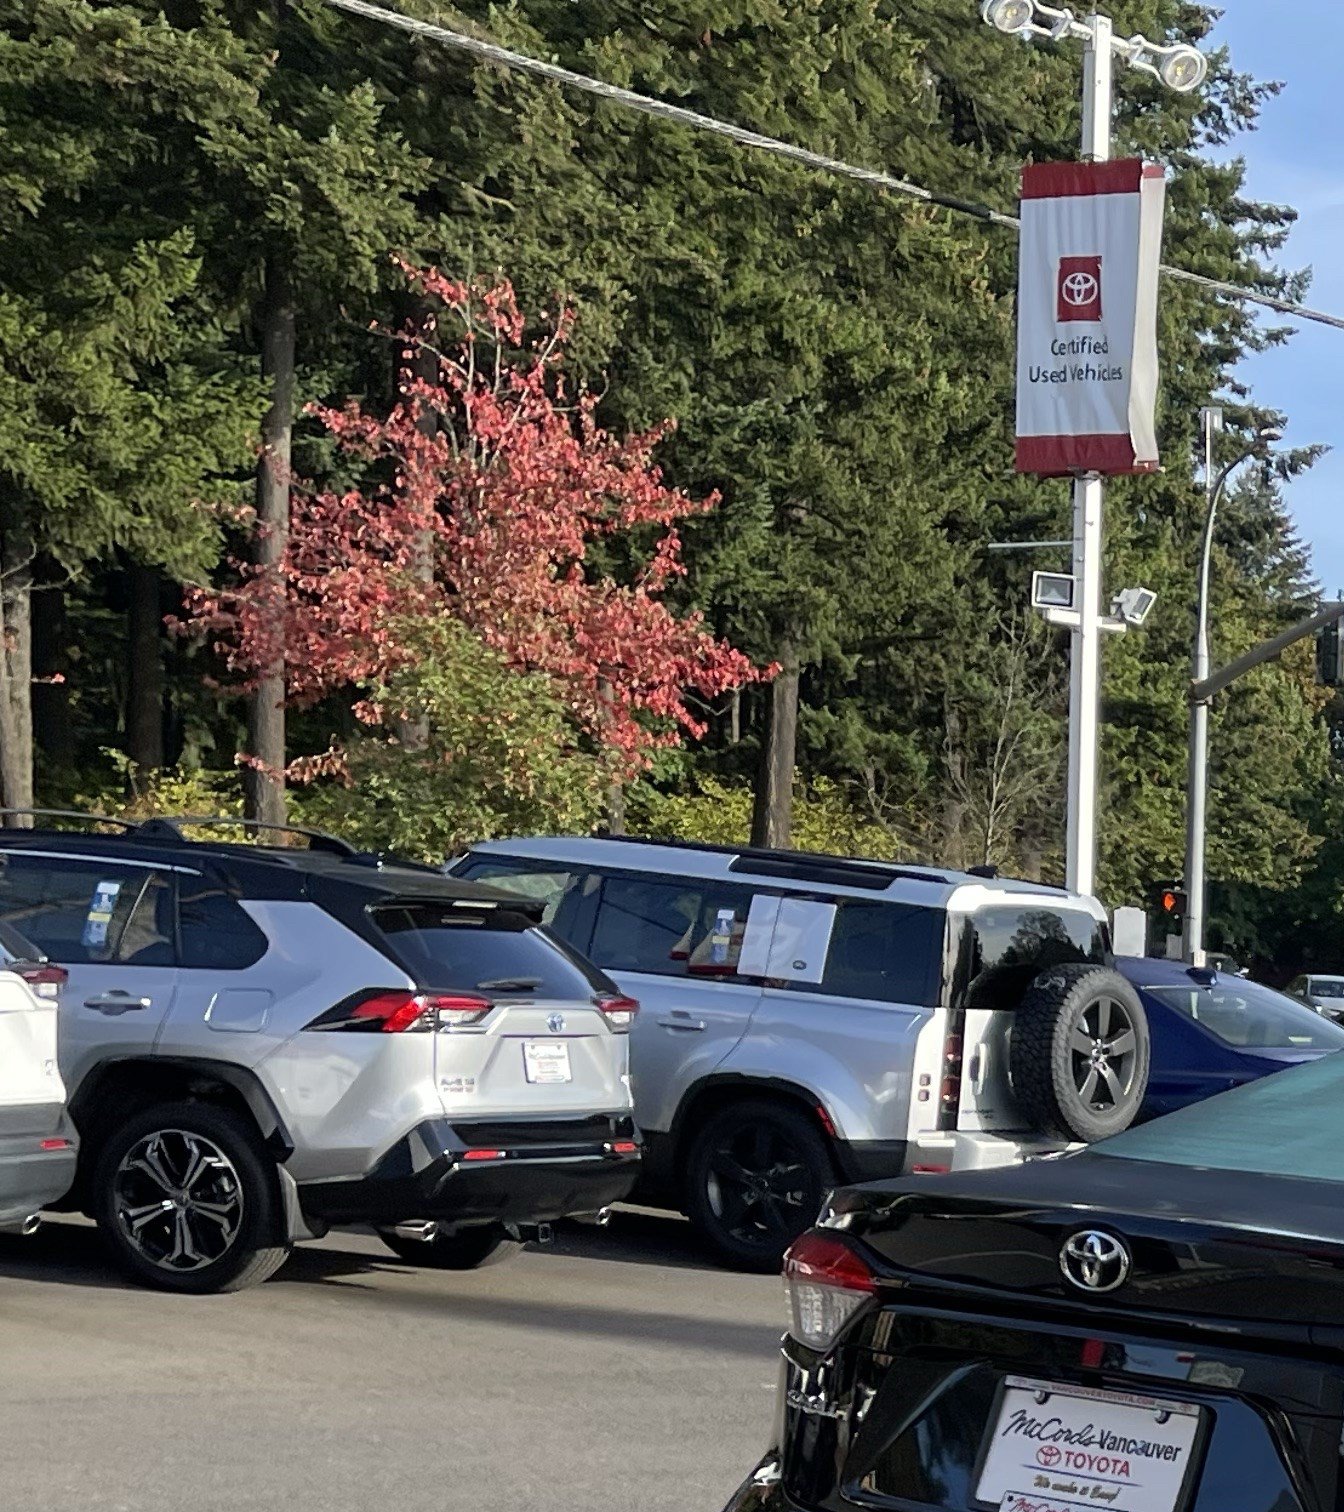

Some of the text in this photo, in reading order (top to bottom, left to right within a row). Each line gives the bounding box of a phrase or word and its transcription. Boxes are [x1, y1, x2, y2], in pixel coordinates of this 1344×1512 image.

[1051, 335, 1109, 356] Certified
[1029, 363, 1123, 384] Used Vehicles
[1099, 1429, 1182, 1462] Vancouver
[1065, 1450, 1131, 1478] TOYOTA
